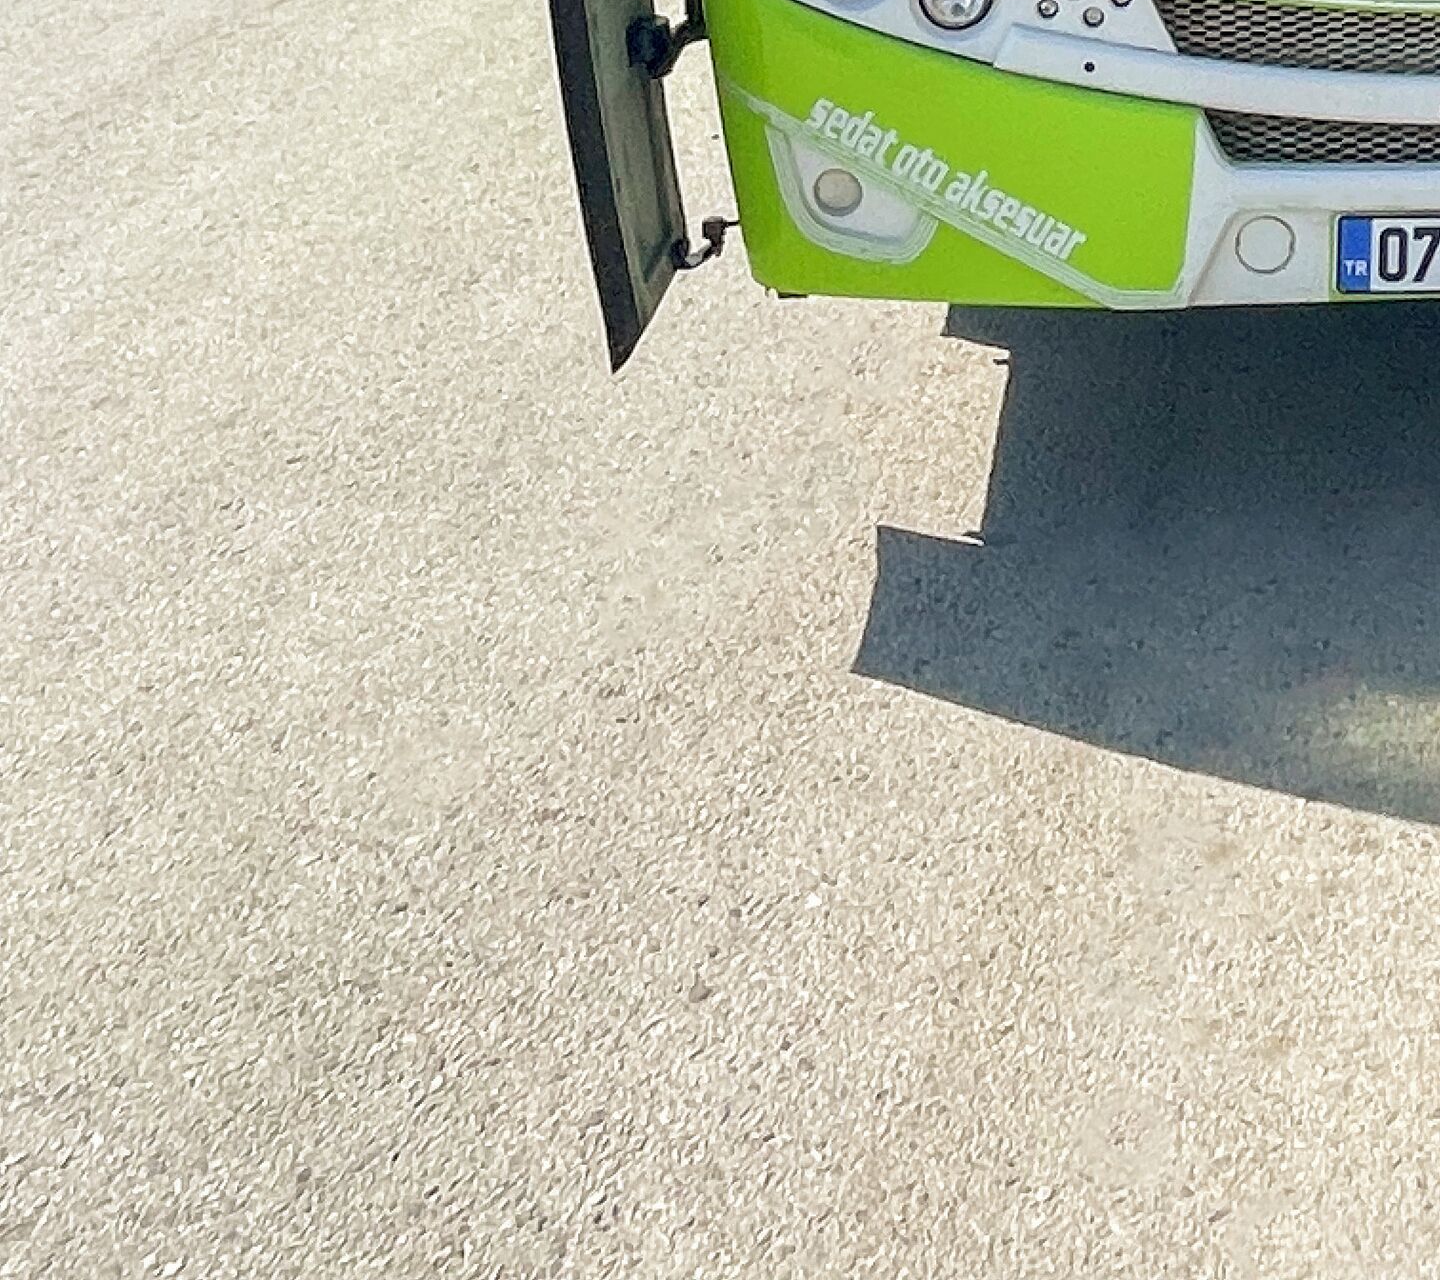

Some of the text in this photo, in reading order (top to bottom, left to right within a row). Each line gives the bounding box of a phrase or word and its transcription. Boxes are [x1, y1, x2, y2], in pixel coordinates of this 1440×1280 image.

[804, 95, 1088, 261] sedat oto aksesuar
[1343, 259, 1369, 278] TR
